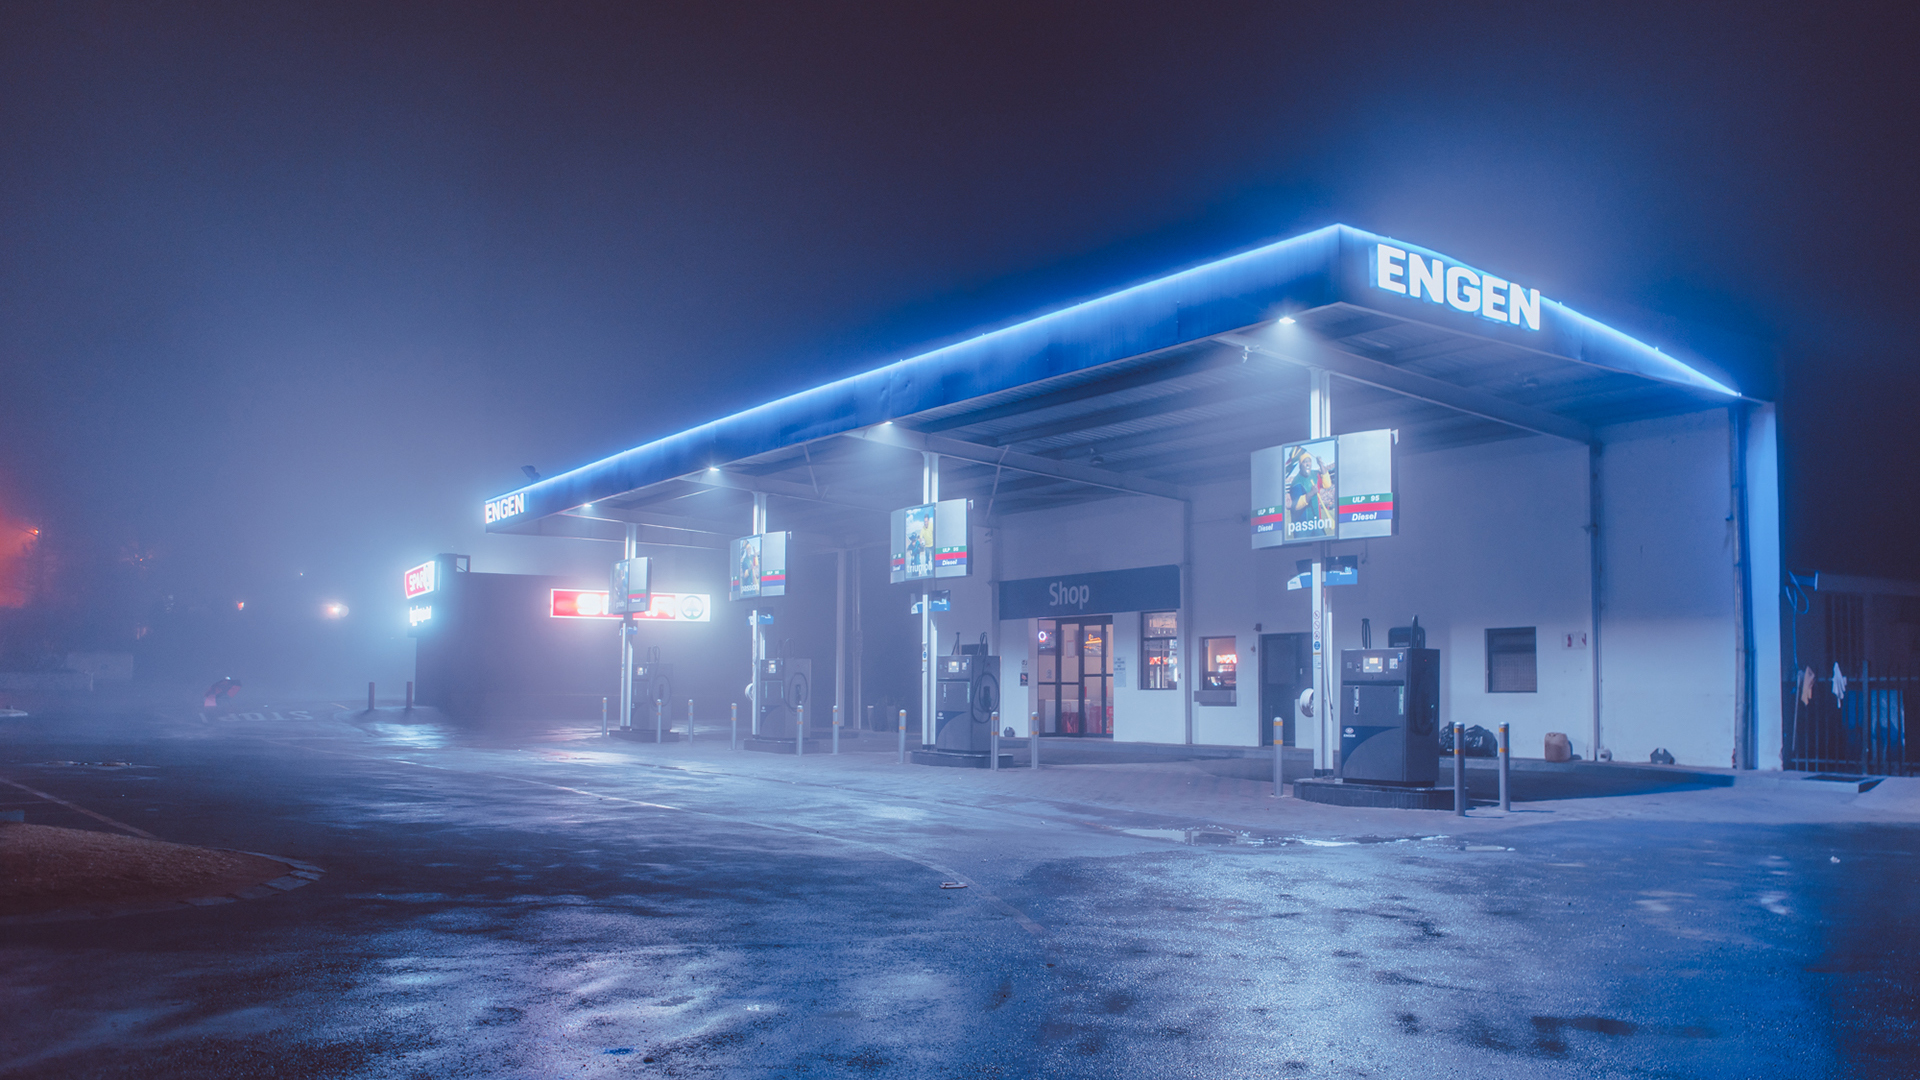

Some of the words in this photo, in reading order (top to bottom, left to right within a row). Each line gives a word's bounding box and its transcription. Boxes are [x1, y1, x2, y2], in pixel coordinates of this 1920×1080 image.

[1377, 243, 1541, 331] ENGEN
[485, 492, 525, 524] ENGEN
[1351, 512, 1378, 522] Diesel
[1257, 523, 1274, 533] Diesel
[1287, 515, 1333, 536] passion
[576, 593, 675, 617] SR
[1048, 581, 1090, 610] Shop
[217, 710, 314, 722] STOP
